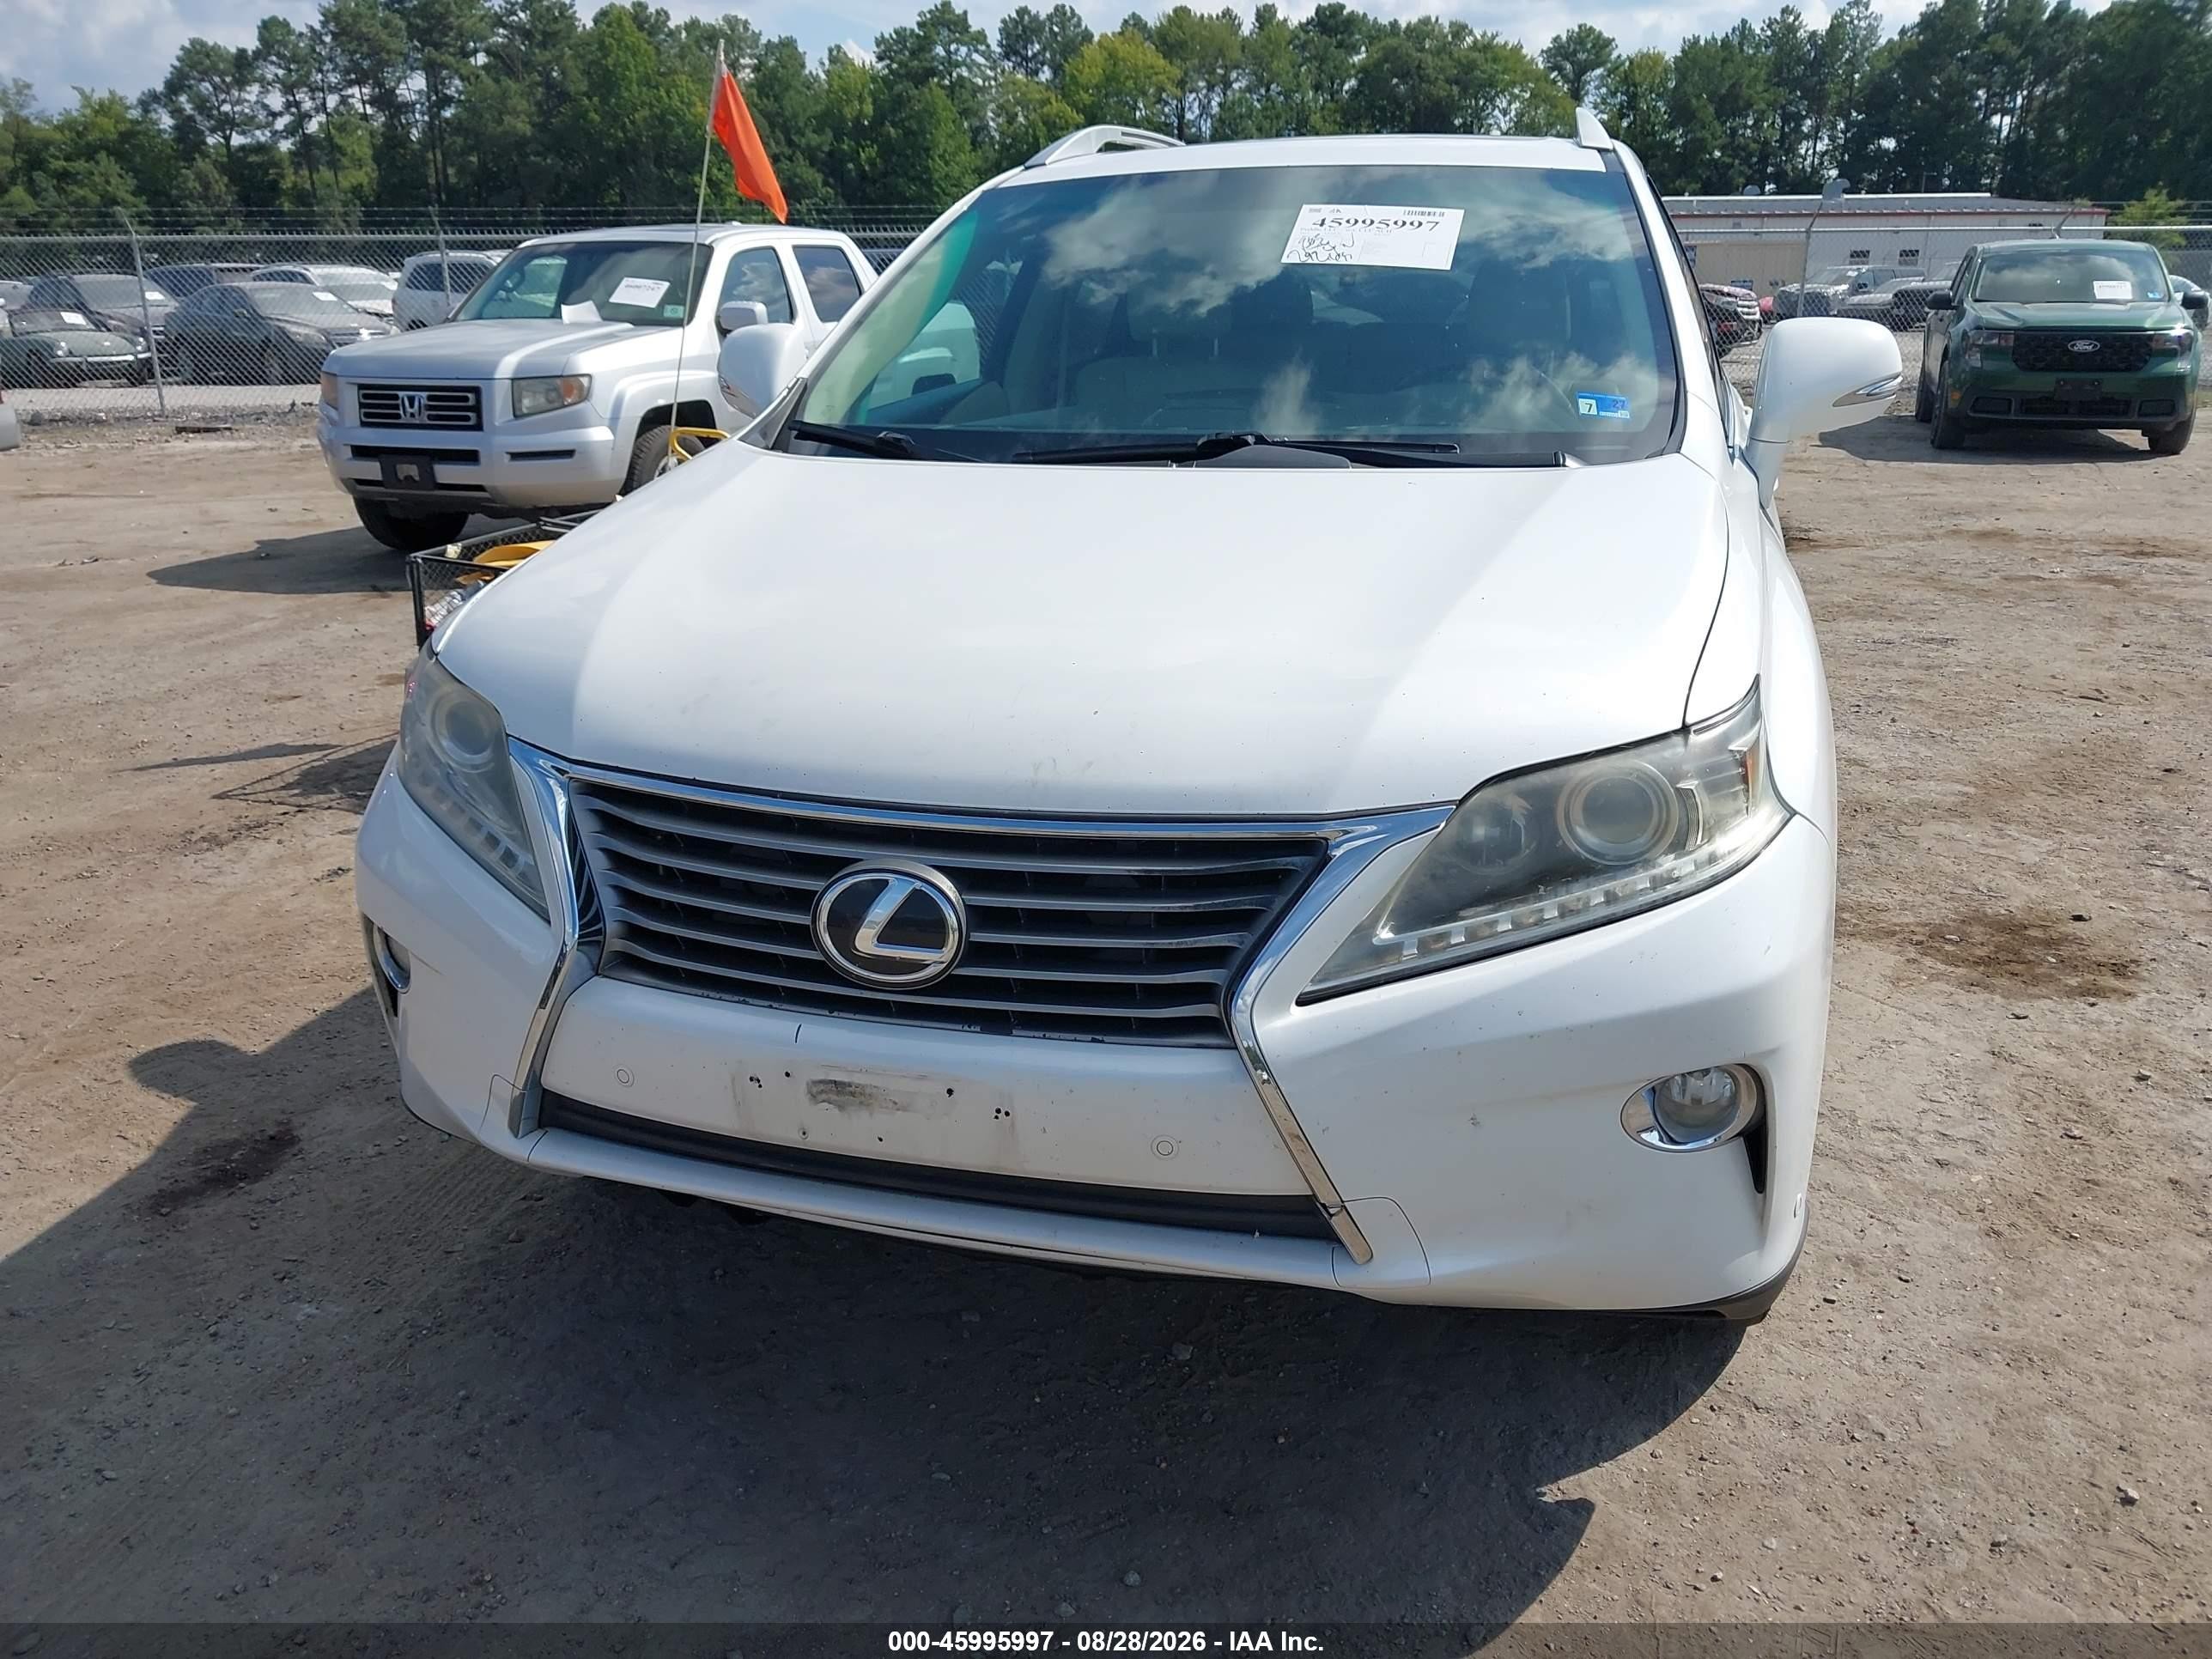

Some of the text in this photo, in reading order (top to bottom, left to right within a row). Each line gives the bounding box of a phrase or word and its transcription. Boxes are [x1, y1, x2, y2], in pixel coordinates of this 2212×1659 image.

[1312, 217, 1440, 232] 45995997
[2073, 343, 2095, 351] Ford
[1584, 402, 1593, 413] 7
